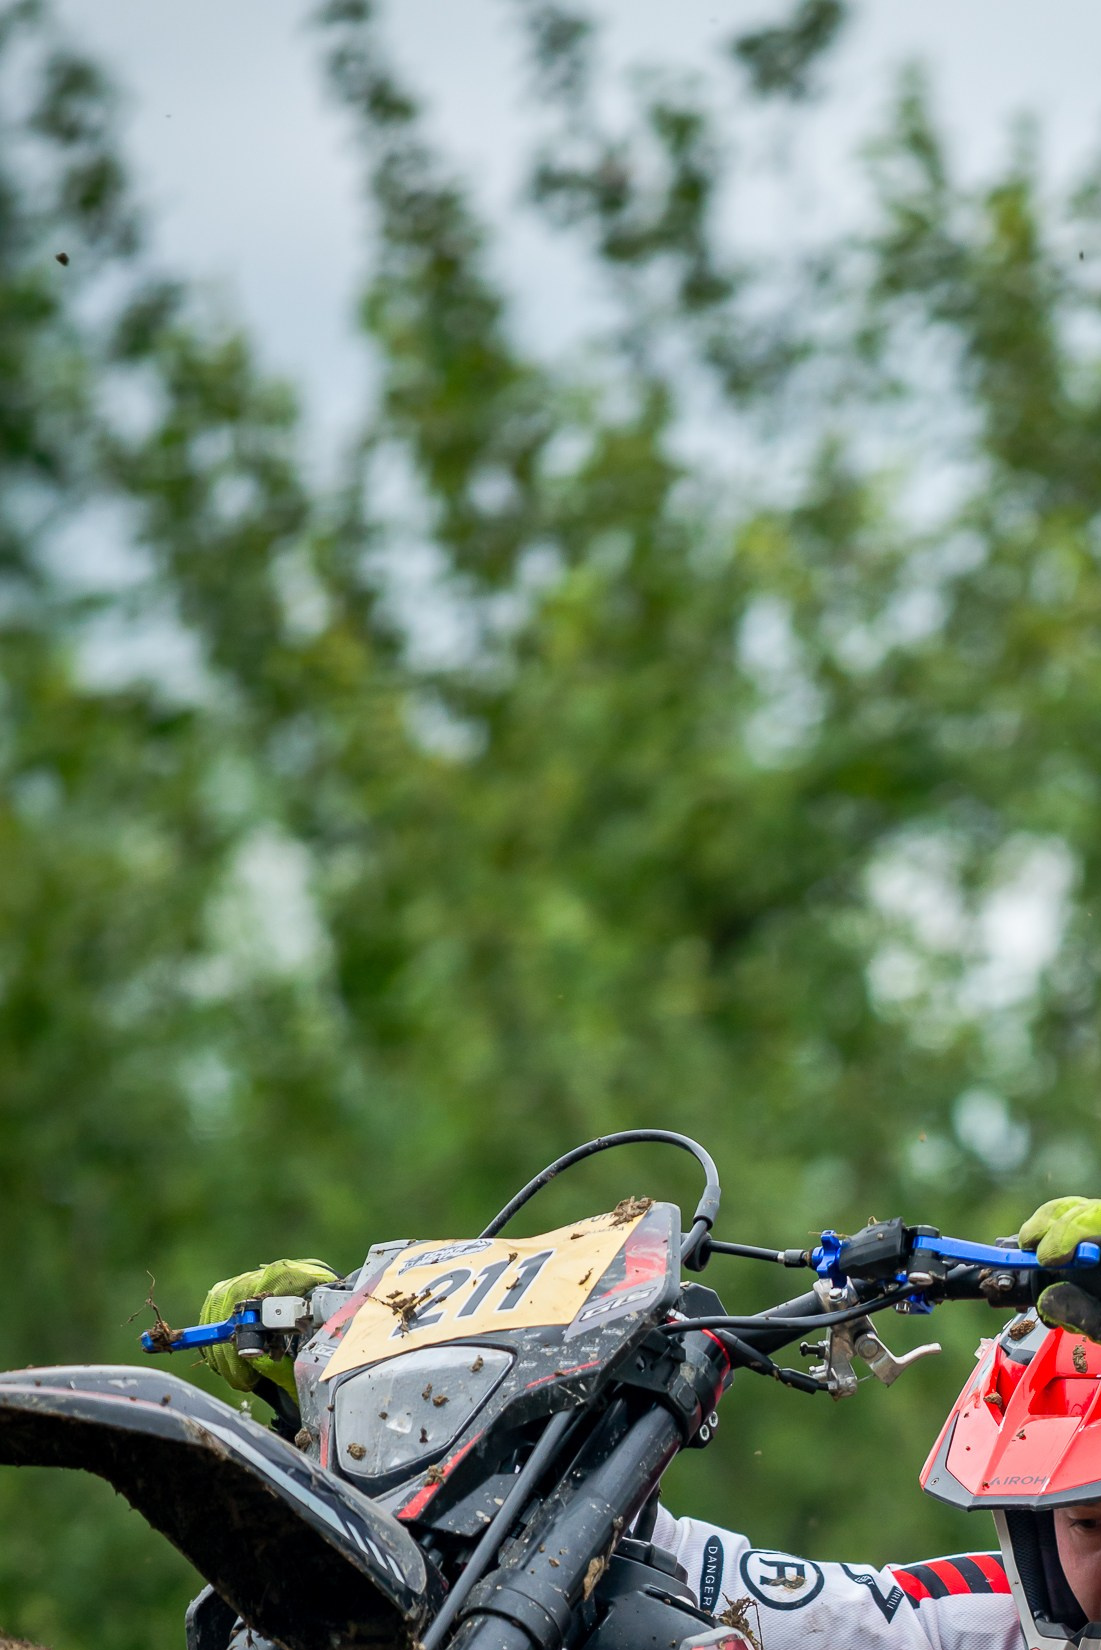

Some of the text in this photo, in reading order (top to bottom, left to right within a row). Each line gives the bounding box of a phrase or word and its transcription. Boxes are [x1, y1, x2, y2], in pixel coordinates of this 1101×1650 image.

[388, 1248, 557, 1340] 211
[990, 1475, 1046, 1486] AIROH
[702, 1546, 718, 1607] DANGER
